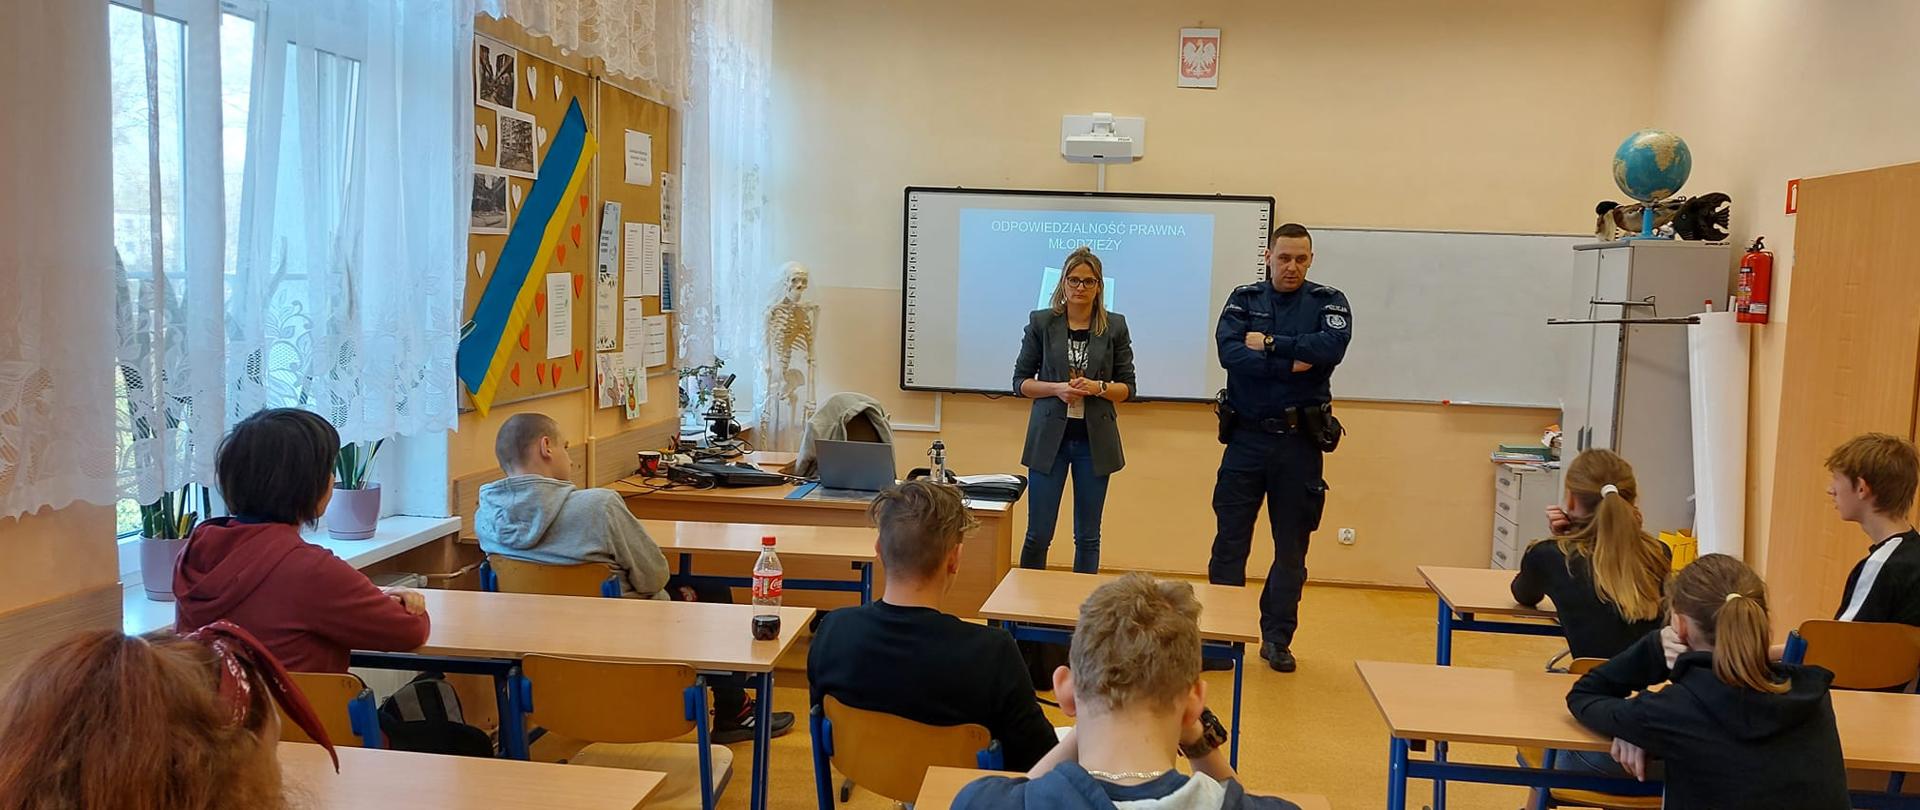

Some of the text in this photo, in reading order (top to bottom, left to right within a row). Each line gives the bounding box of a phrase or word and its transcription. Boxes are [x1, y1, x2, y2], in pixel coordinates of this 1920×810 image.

[991, 220, 1186, 236] ODPOWIEDZIALNOŚĆ PRAWNA
[1049, 237, 1122, 250] MŁODZIEŻY
